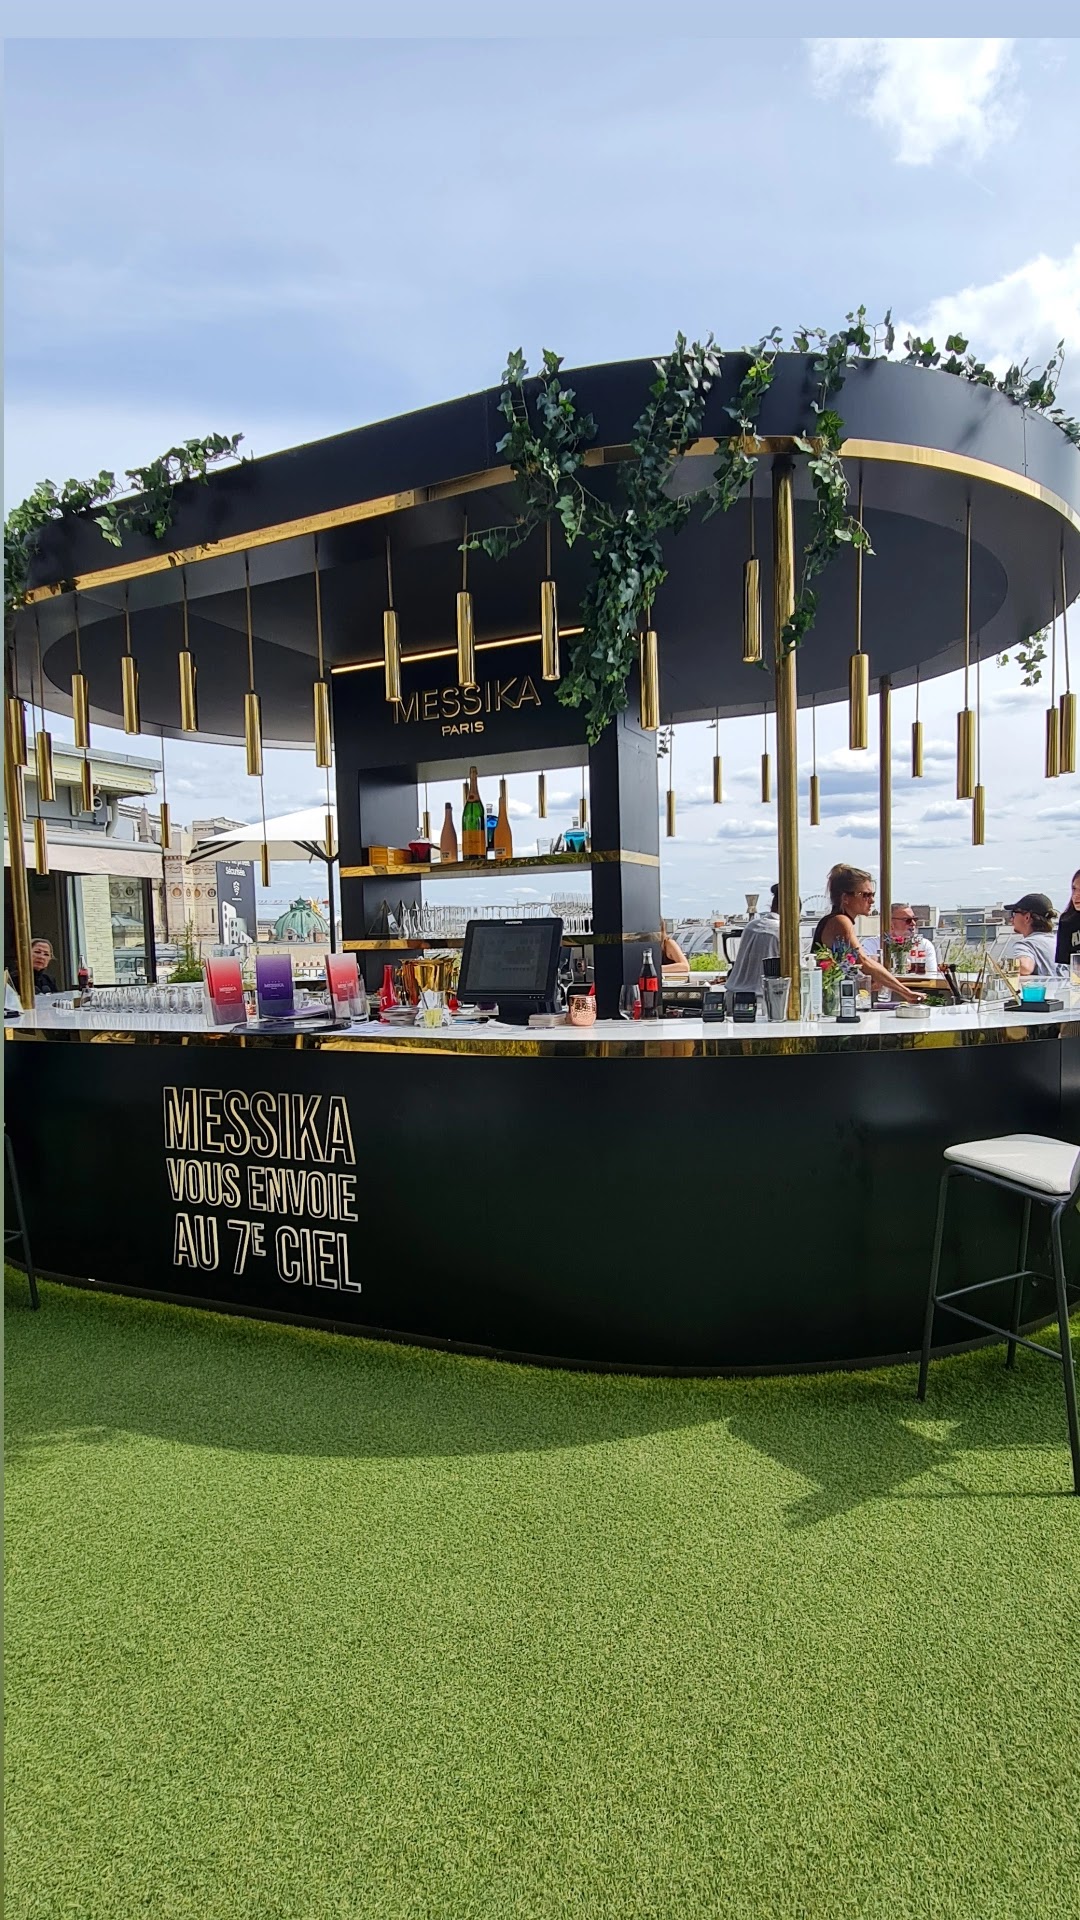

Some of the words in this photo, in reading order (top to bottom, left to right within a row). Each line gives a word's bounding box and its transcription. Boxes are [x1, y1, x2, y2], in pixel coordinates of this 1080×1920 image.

[393, 675, 542, 724] MESSIKA
[441, 721, 485, 737] PARIS
[163, 1086, 357, 1165] MESSIKA
[166, 1157, 241, 1208] VOUS
[247, 1165, 359, 1222] ENVOIE
[173, 1212, 219, 1271] AU
[275, 1225, 362, 1293] CIEL
